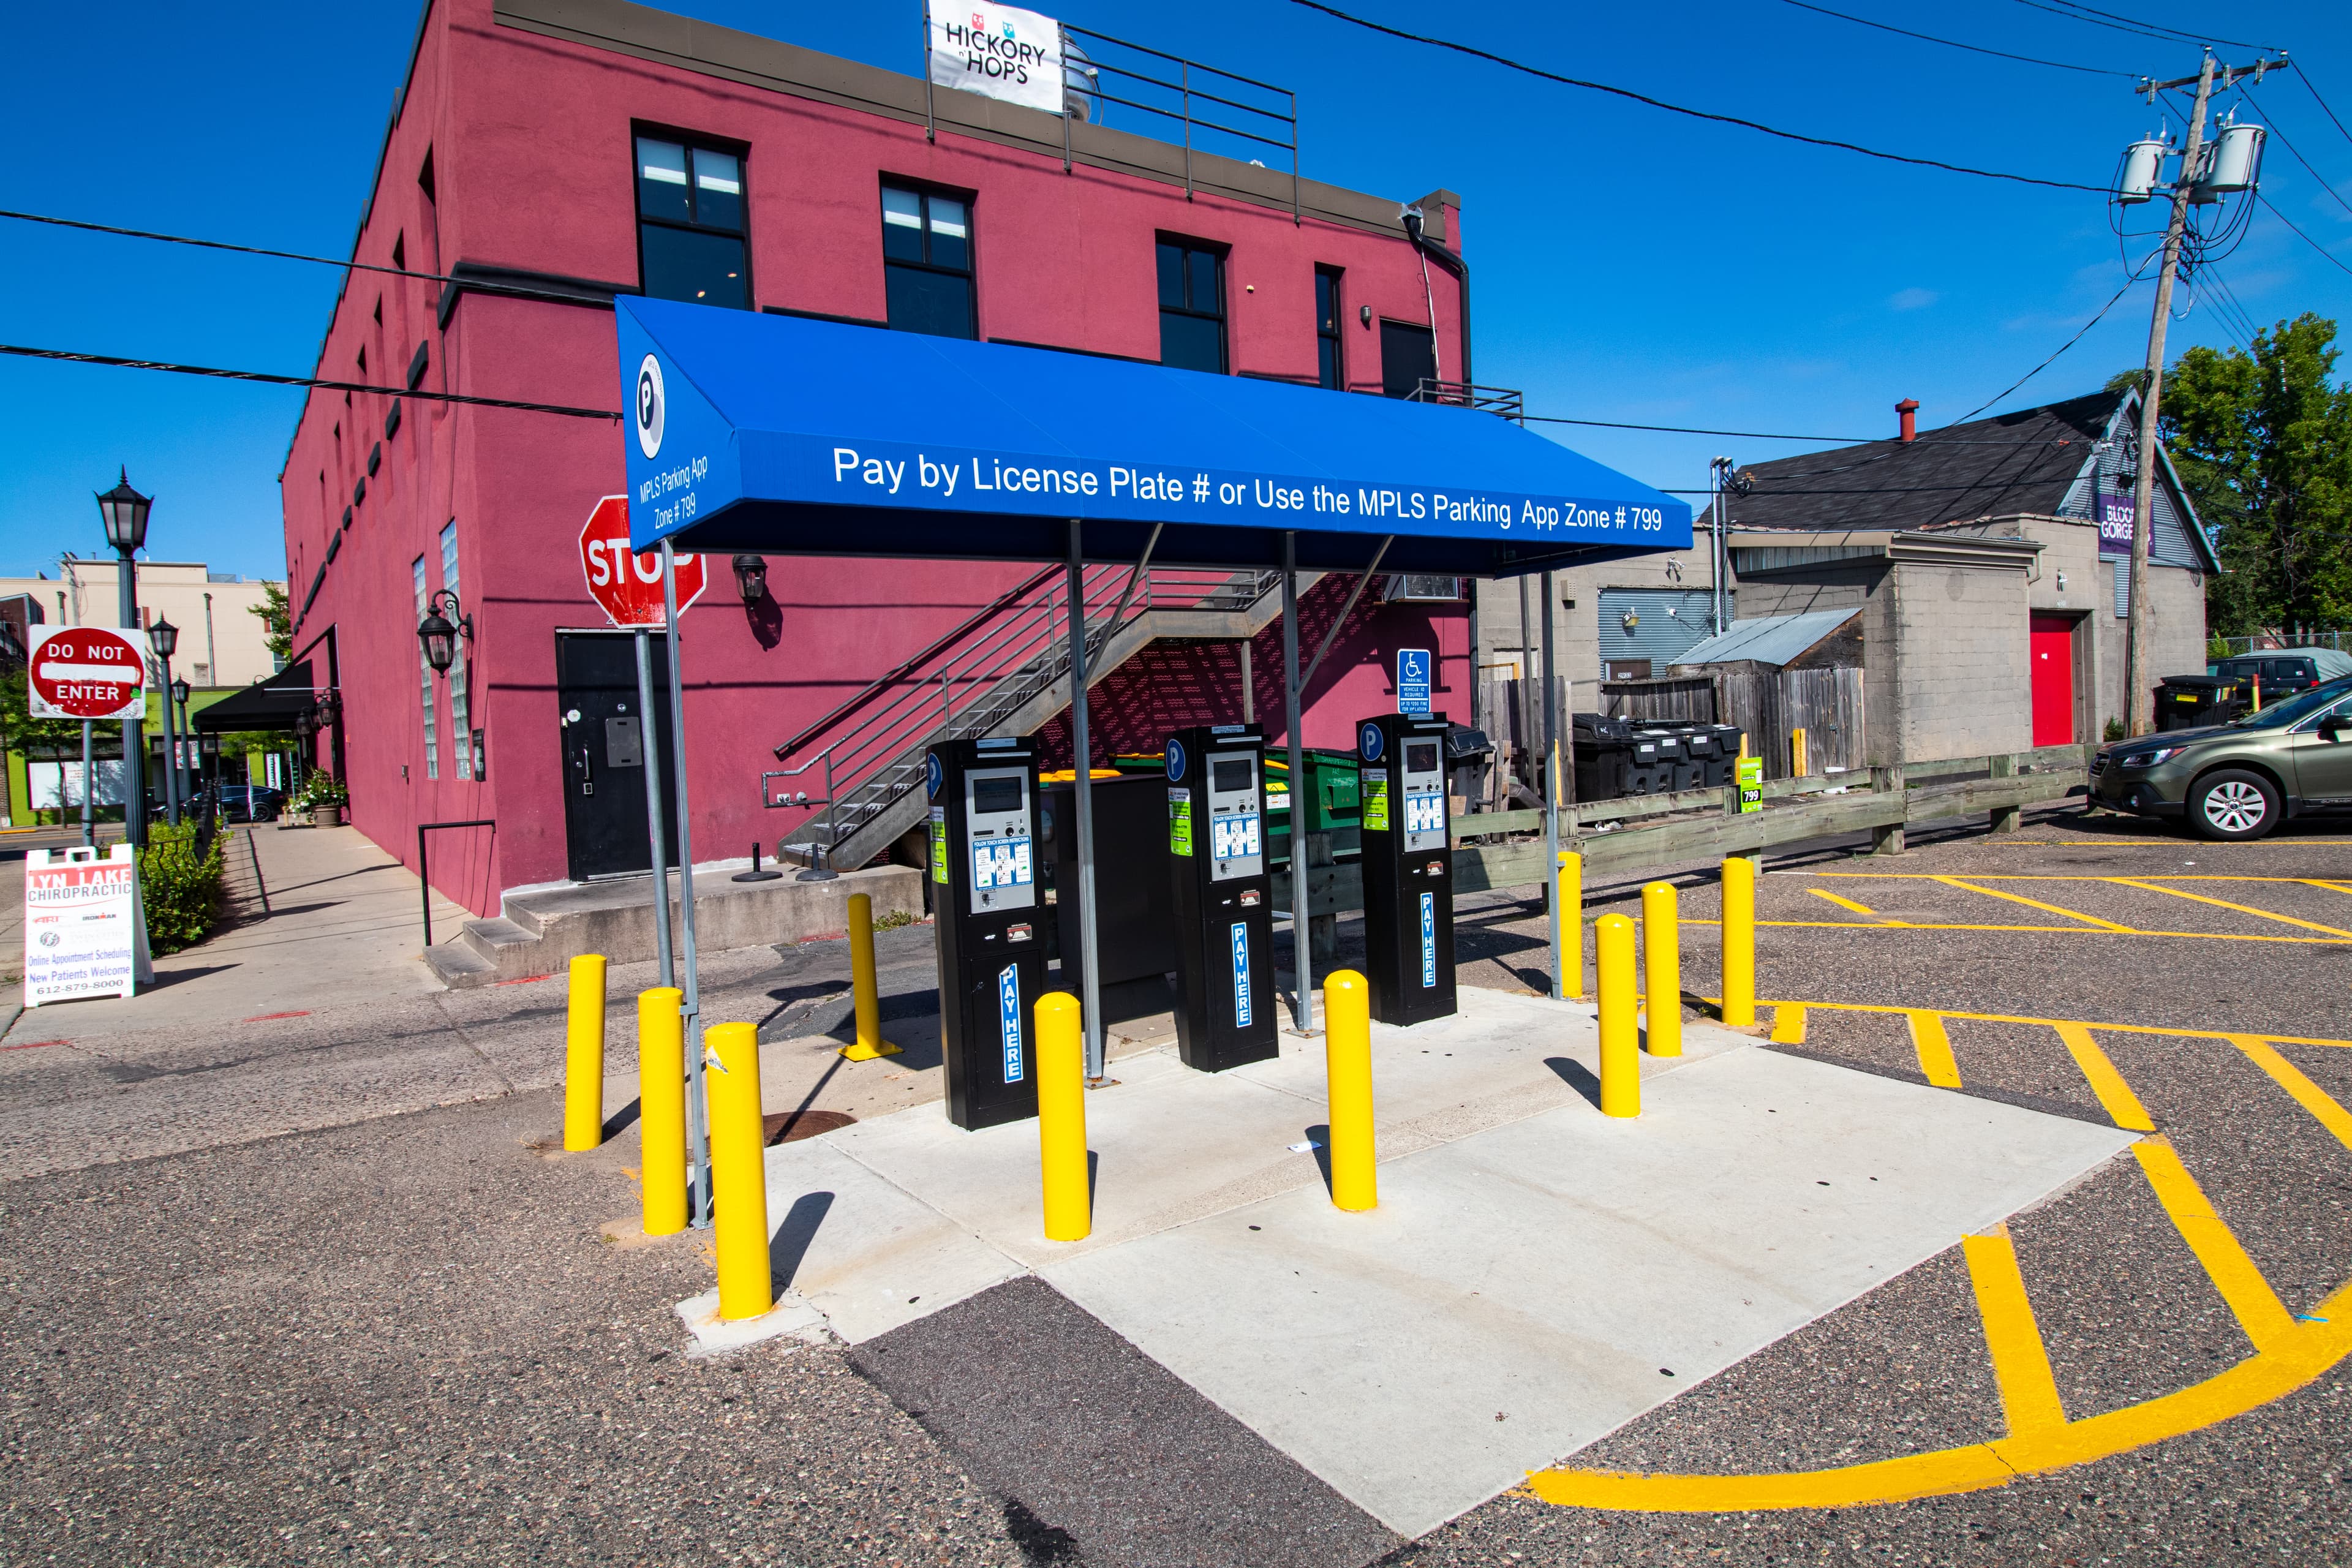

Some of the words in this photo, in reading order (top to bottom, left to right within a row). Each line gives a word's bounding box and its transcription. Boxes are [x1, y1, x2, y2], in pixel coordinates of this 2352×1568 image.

[946, 23, 1046, 67] HICKORY
[967, 51, 1028, 85] HOPS
[640, 478, 661, 505] MPLS
[662, 464, 690, 491] Parking
[692, 456, 707, 480] App
[834, 448, 905, 494] Pay
[919, 454, 960, 497] by
[973, 458, 1098, 496] License
[1110, 467, 1183, 501] Plate
[1193, 473, 1210, 503] #
[1219, 483, 1246, 505] or
[1255, 479, 1304, 510] Use
[1313, 484, 1350, 514] the
[1359, 489, 1426, 519] MPLS
[1434, 494, 1511, 529] Parking
[1521, 500, 1559, 531] App
[1565, 503, 1610, 528] Zone
[1615, 506, 1626, 529] #
[1631, 507, 1662, 531] 799
[655, 508, 673, 529] Zone
[674, 500, 680, 522] #
[681, 492, 696, 519] 799
[588, 538, 693, 586] STO
[48, 643, 74, 658] DO
[88, 646, 124, 660] NOT
[57, 685, 119, 700] ENTER
[1366, 731, 1376, 755] P
[1170, 747, 1179, 774] P
[1744, 790, 1758, 802] 799
[28, 883, 131, 902] CHIROPRACTIC
[29, 873, 67, 891] LYN
[80, 869, 131, 886] LAKE
[29, 955, 50, 967] Online
[52, 952, 93, 965] Appointment
[96, 948, 131, 960] Scheduling
[1235, 928, 1245, 966] PAY
[1425, 937, 1434, 982] HERE
[29, 973, 48, 984] New
[51, 970, 88, 982] Patients
[91, 965, 130, 978] Welcome
[37, 979, 124, 995] 612-879-8000
[1003, 970, 1016, 1013] PAY
[1237, 971, 1249, 1022] HERE
[1005, 1019, 1020, 1077] HERE
